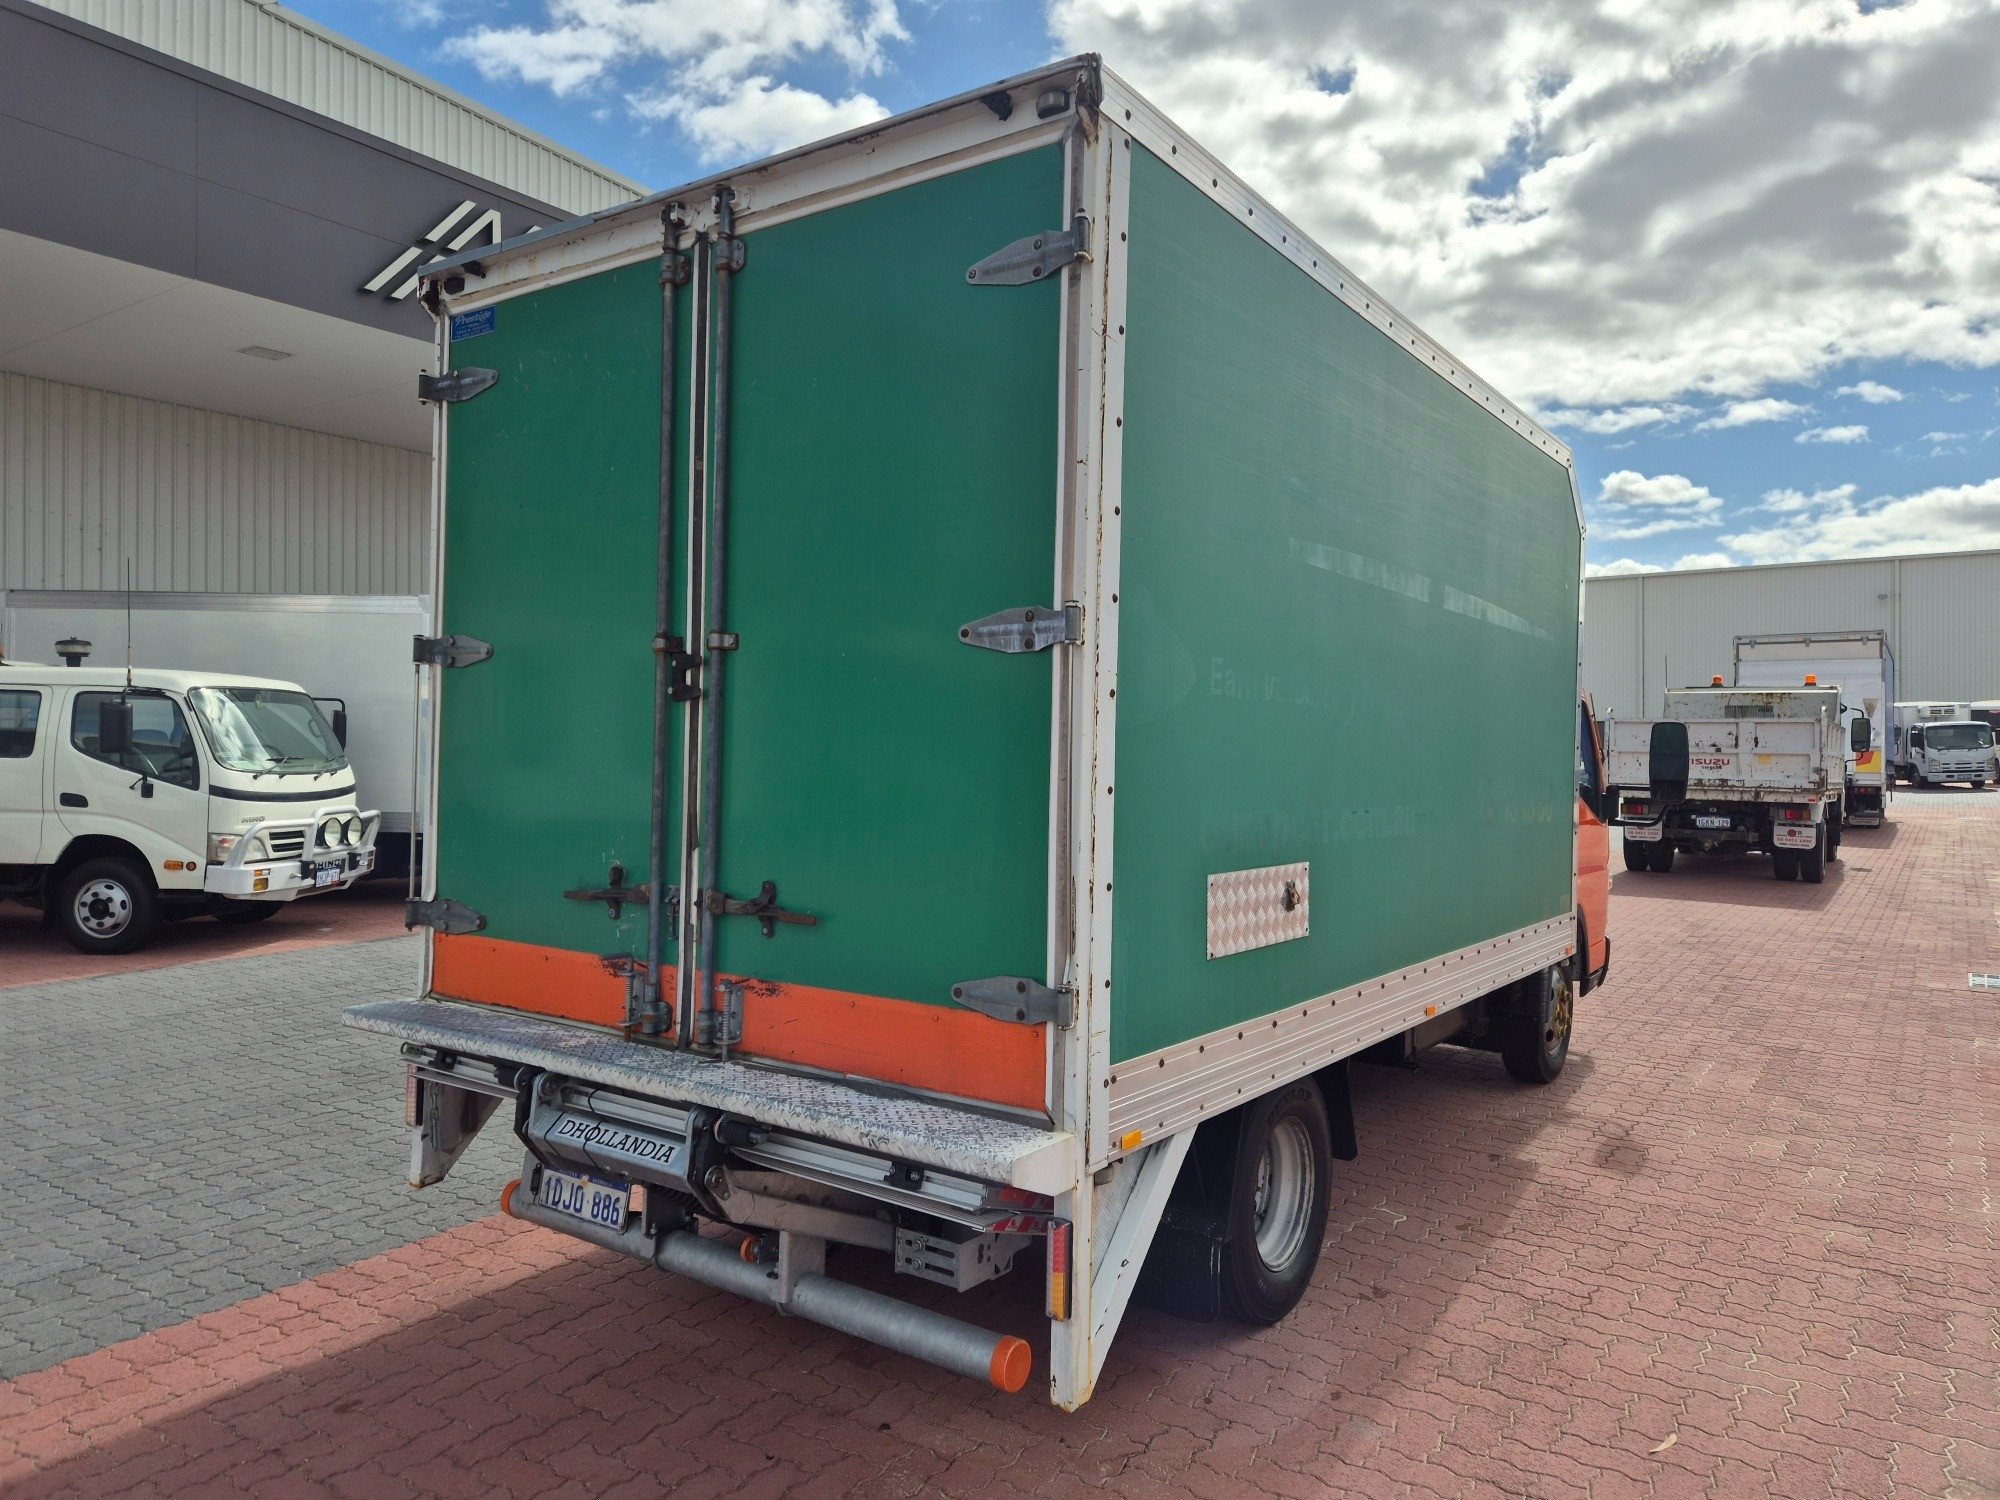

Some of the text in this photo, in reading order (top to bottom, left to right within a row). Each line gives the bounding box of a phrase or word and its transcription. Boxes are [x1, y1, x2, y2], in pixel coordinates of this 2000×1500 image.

[455, 311, 491, 326] Prestige
[1691, 758, 1730, 766] ISUZU
[316, 859, 341, 868] HINO
[558, 1120, 675, 1163] DHOLLANDIA
[591, 1191, 620, 1225] 886
